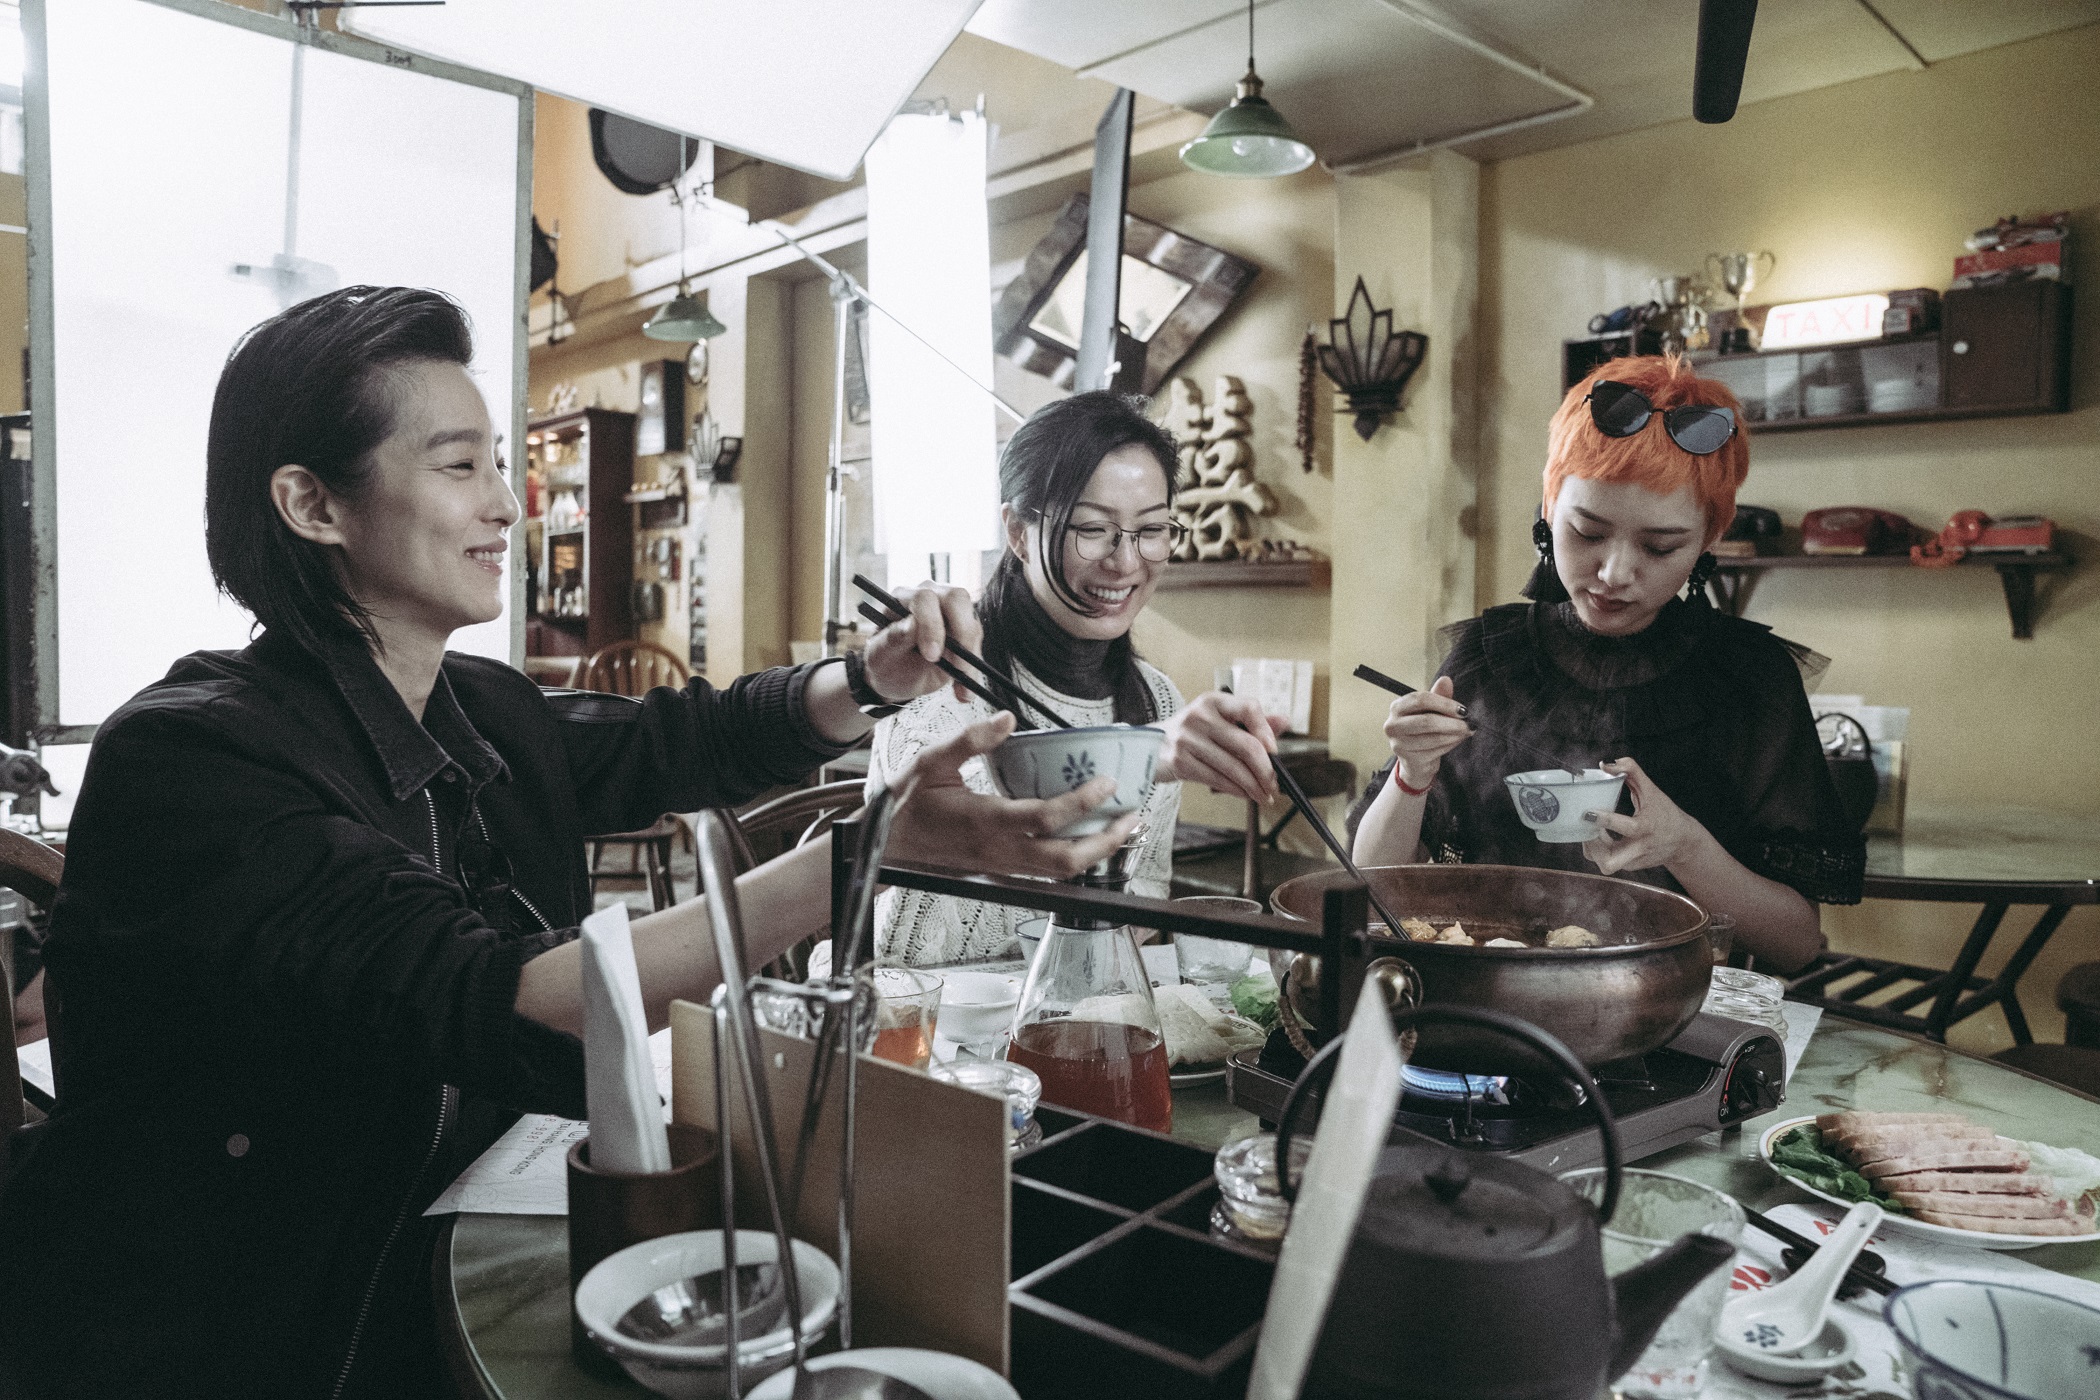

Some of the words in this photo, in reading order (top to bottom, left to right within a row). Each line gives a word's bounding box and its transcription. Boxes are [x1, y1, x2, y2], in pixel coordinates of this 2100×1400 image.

[1774, 303, 1870, 338] TAXI
[1719, 1108, 1729, 1117] ON
[525, 1146, 547, 1160] HONG
[509, 1160, 531, 1175] KONG
